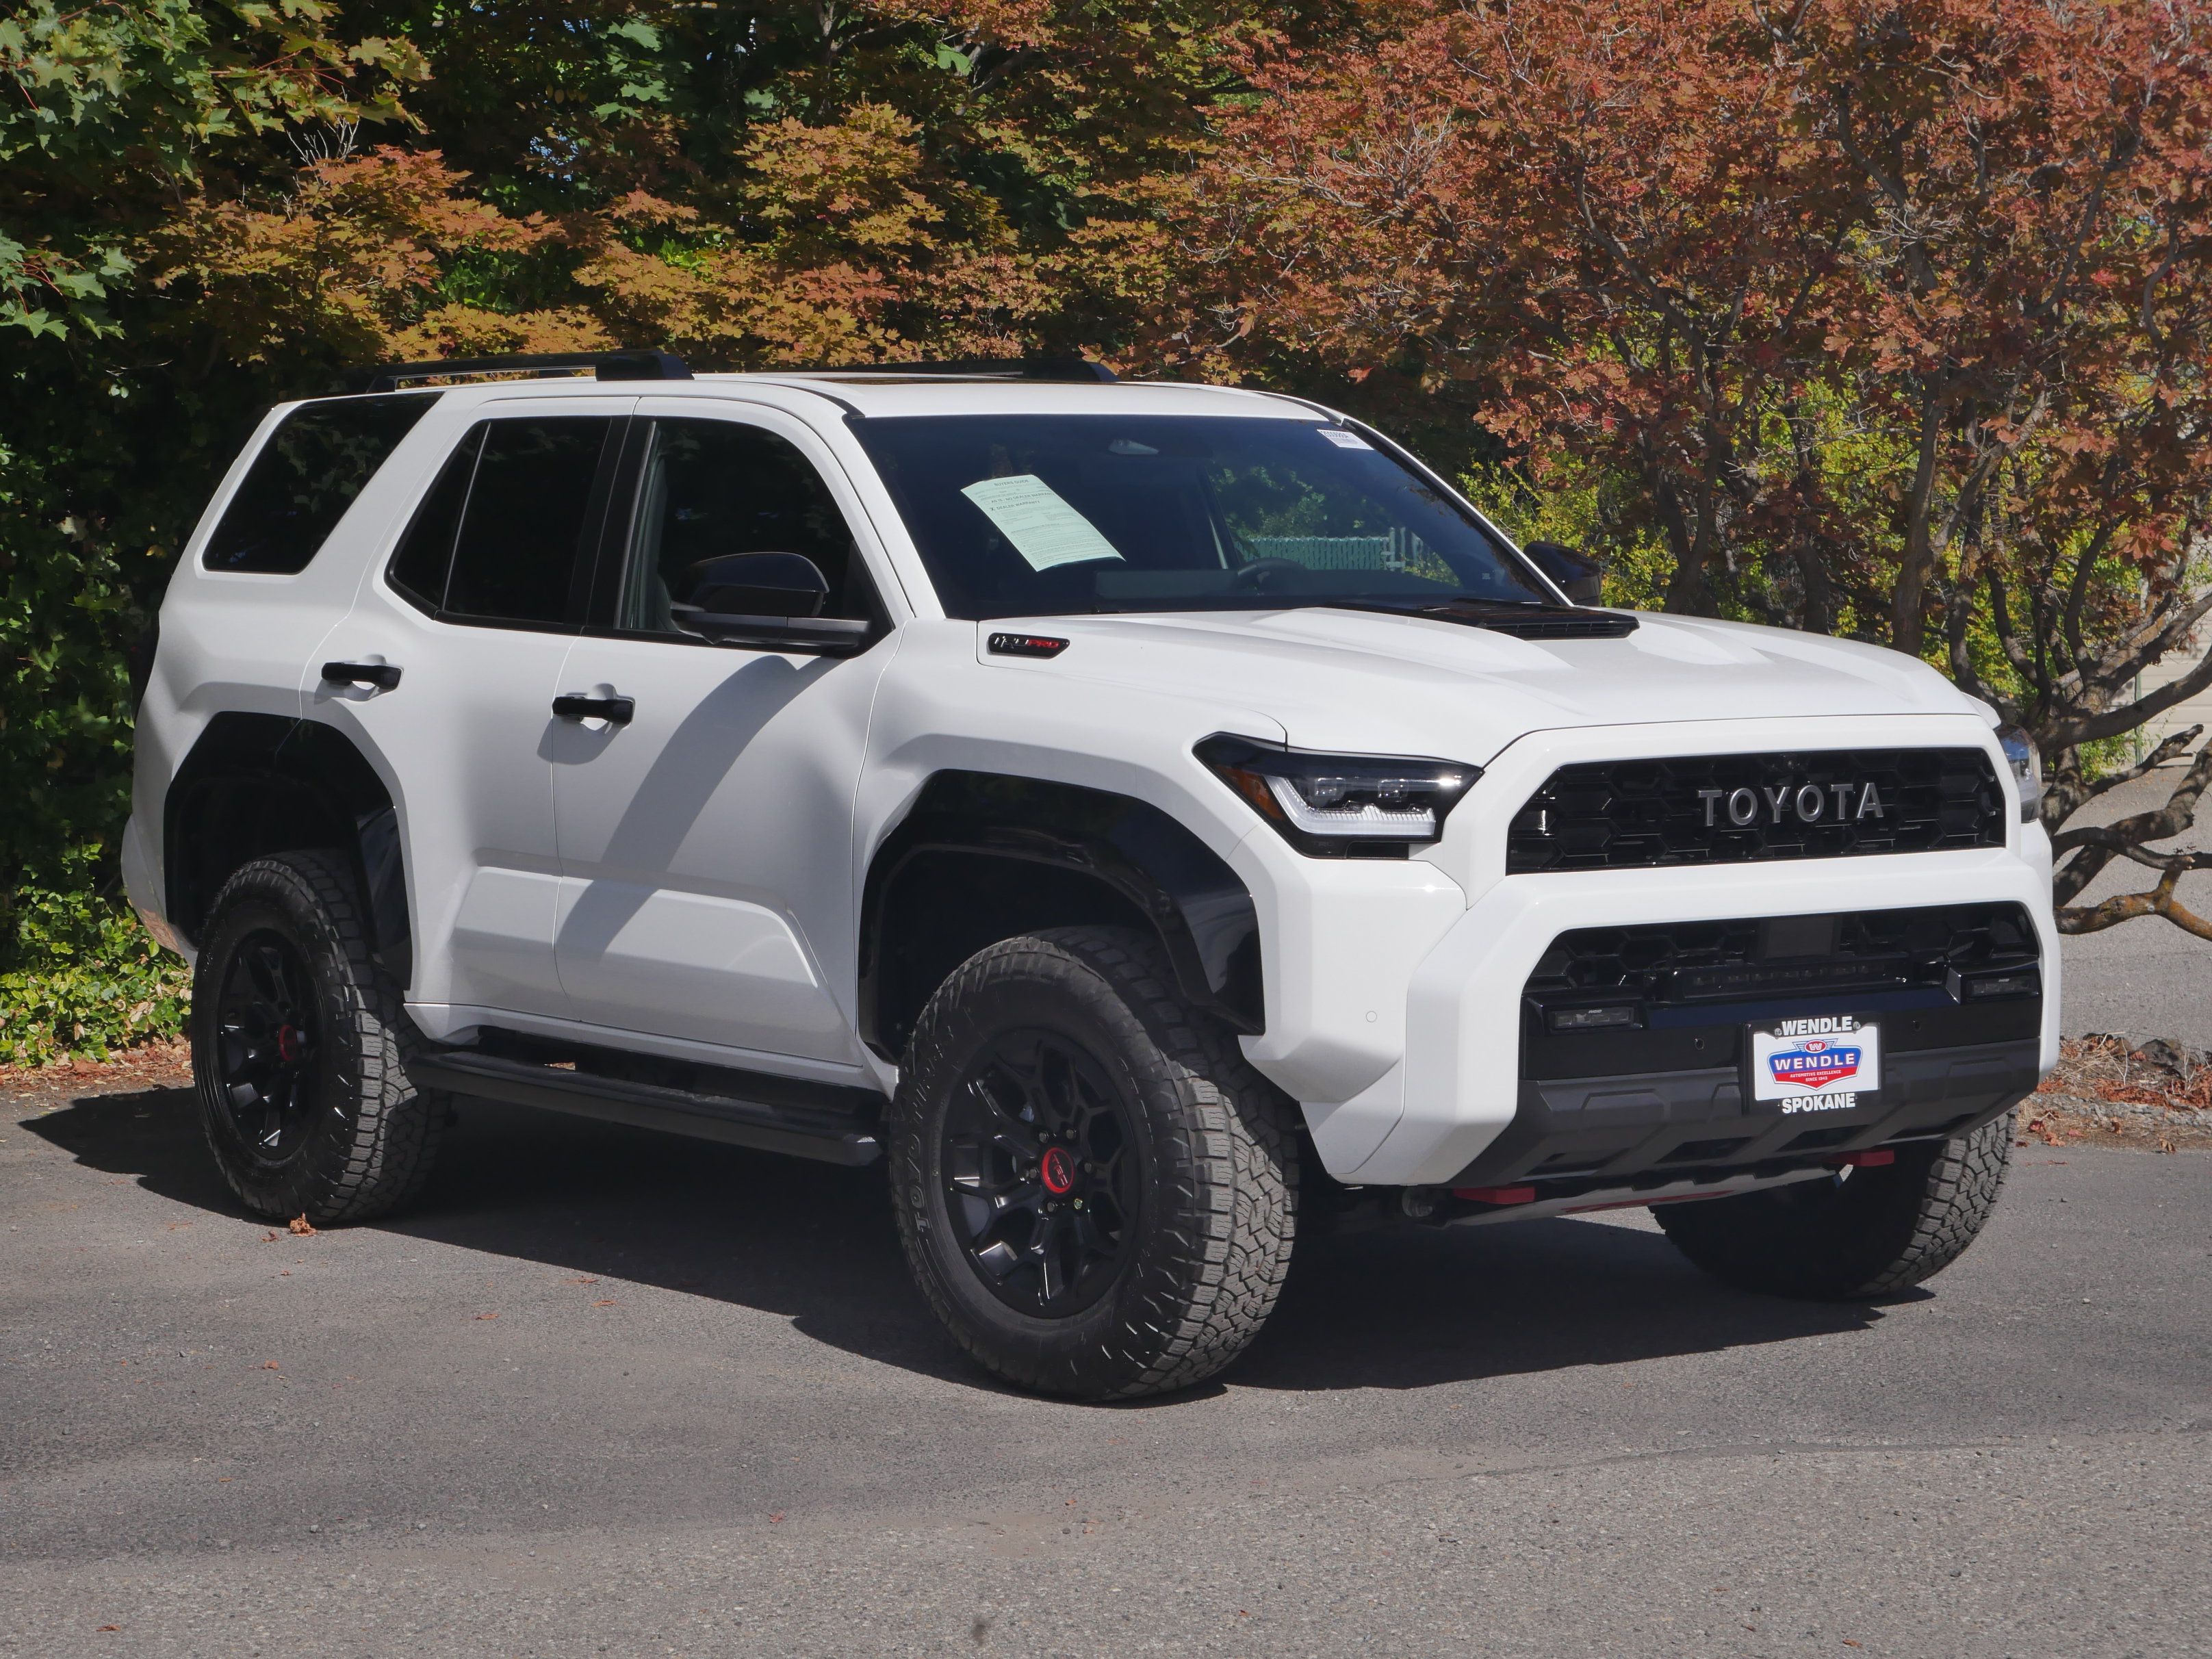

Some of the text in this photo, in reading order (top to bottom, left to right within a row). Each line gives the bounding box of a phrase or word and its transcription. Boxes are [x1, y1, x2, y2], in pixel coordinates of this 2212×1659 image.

[1697, 782, 1885, 827] TOYOTA
[1781, 1016, 1853, 1036] WENDLE
[1774, 1053, 1855, 1071] WENDLE
[1782, 1092, 1856, 1114] SPOKANE
